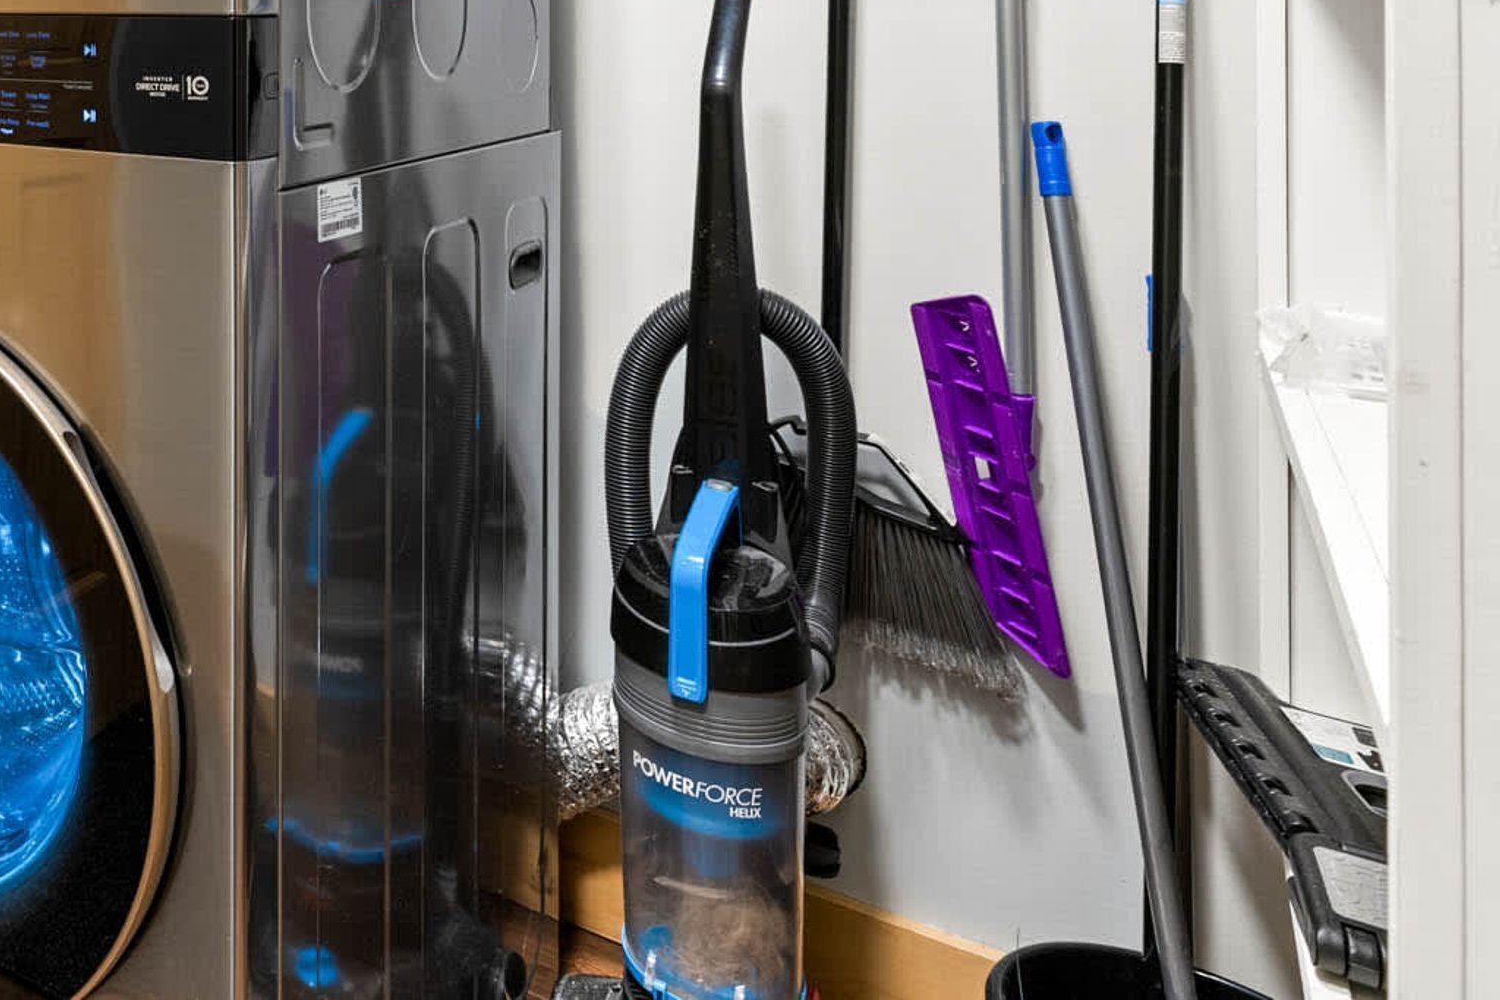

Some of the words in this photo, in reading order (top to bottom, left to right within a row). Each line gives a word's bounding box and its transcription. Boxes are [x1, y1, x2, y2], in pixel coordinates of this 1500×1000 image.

[134, 82, 159, 91] DIRECT
[160, 82, 180, 92] DRIVE
[632, 749, 763, 807] POWERFORCE
[729, 807, 762, 819] HELIX
